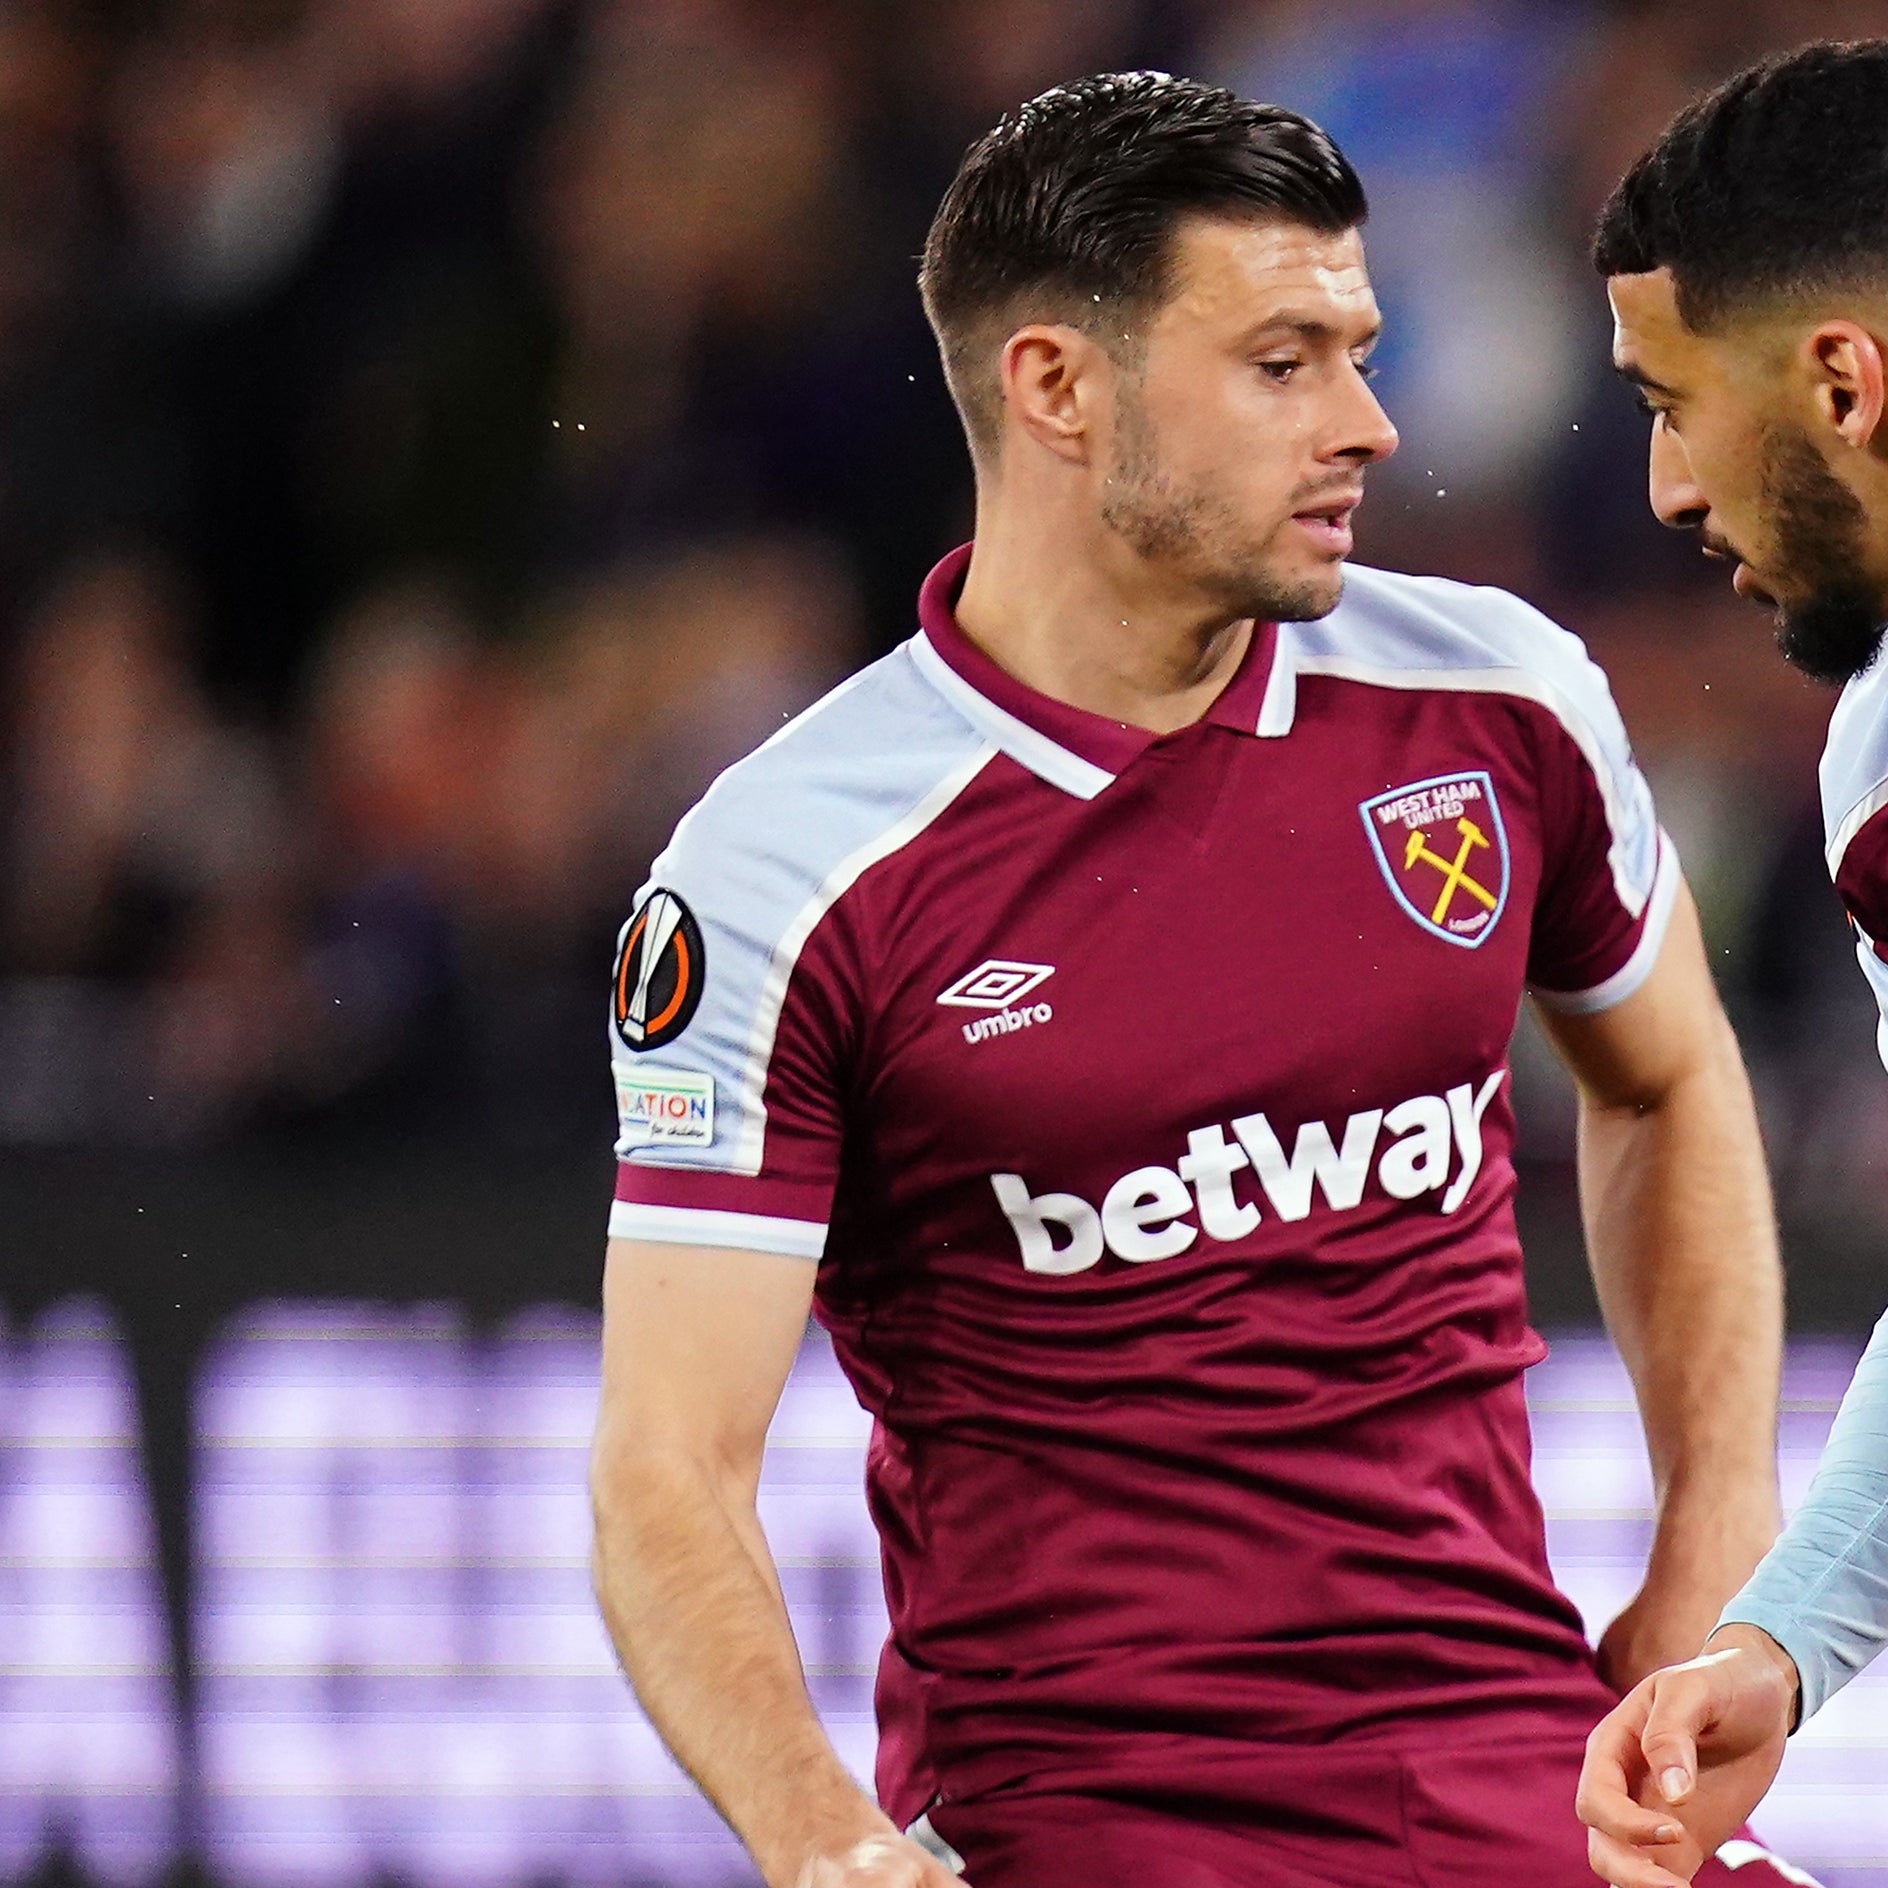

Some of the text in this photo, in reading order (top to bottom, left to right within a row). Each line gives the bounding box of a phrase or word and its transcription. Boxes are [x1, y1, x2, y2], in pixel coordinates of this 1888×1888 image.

[1377, 782, 1481, 825] WEST HAM
[1403, 800, 1464, 830] UNITED
[962, 1002, 1053, 1044] umbro
[621, 1091, 706, 1119] ATION
[989, 1069, 1507, 1276] betway
